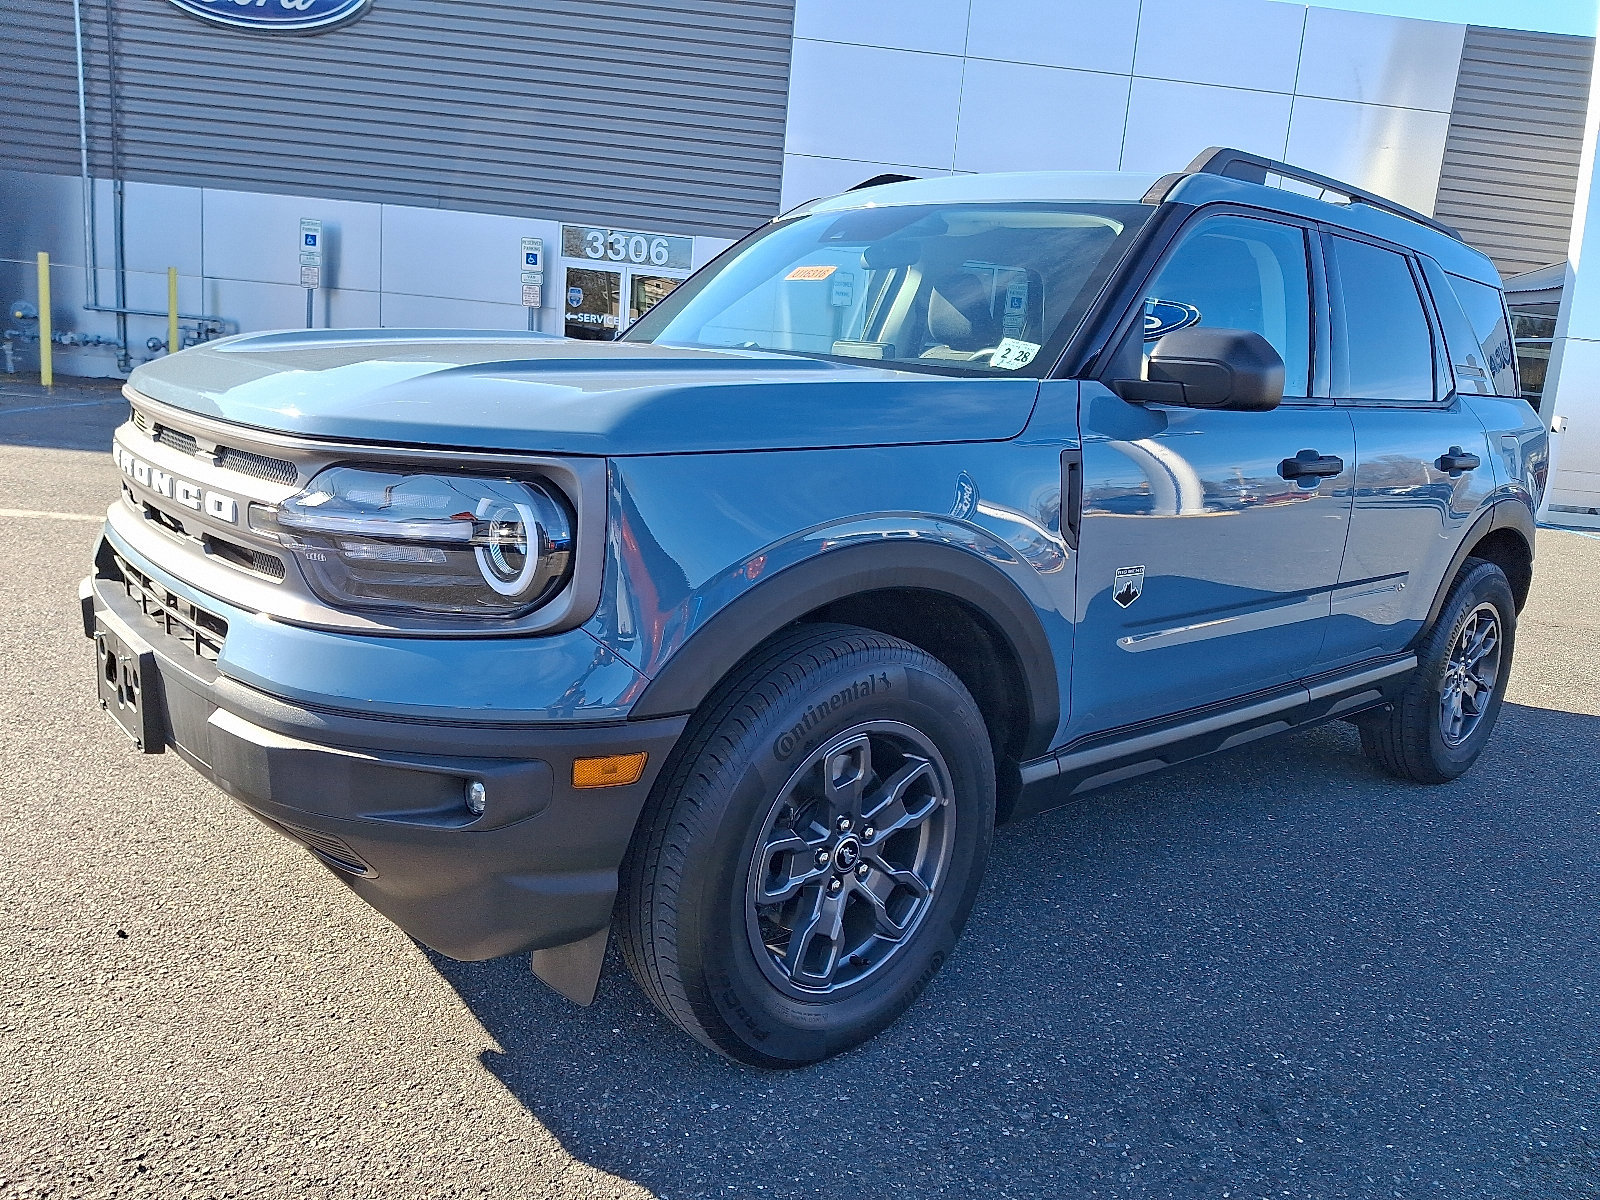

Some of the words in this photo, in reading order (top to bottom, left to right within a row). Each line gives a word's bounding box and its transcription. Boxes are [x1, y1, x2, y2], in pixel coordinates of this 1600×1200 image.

[585, 231, 669, 265] 3306
[577, 313, 620, 324] SERVICE
[1001, 347, 1012, 359] 2
[1014, 350, 1031, 362] 28
[772, 673, 877, 762] Continental
